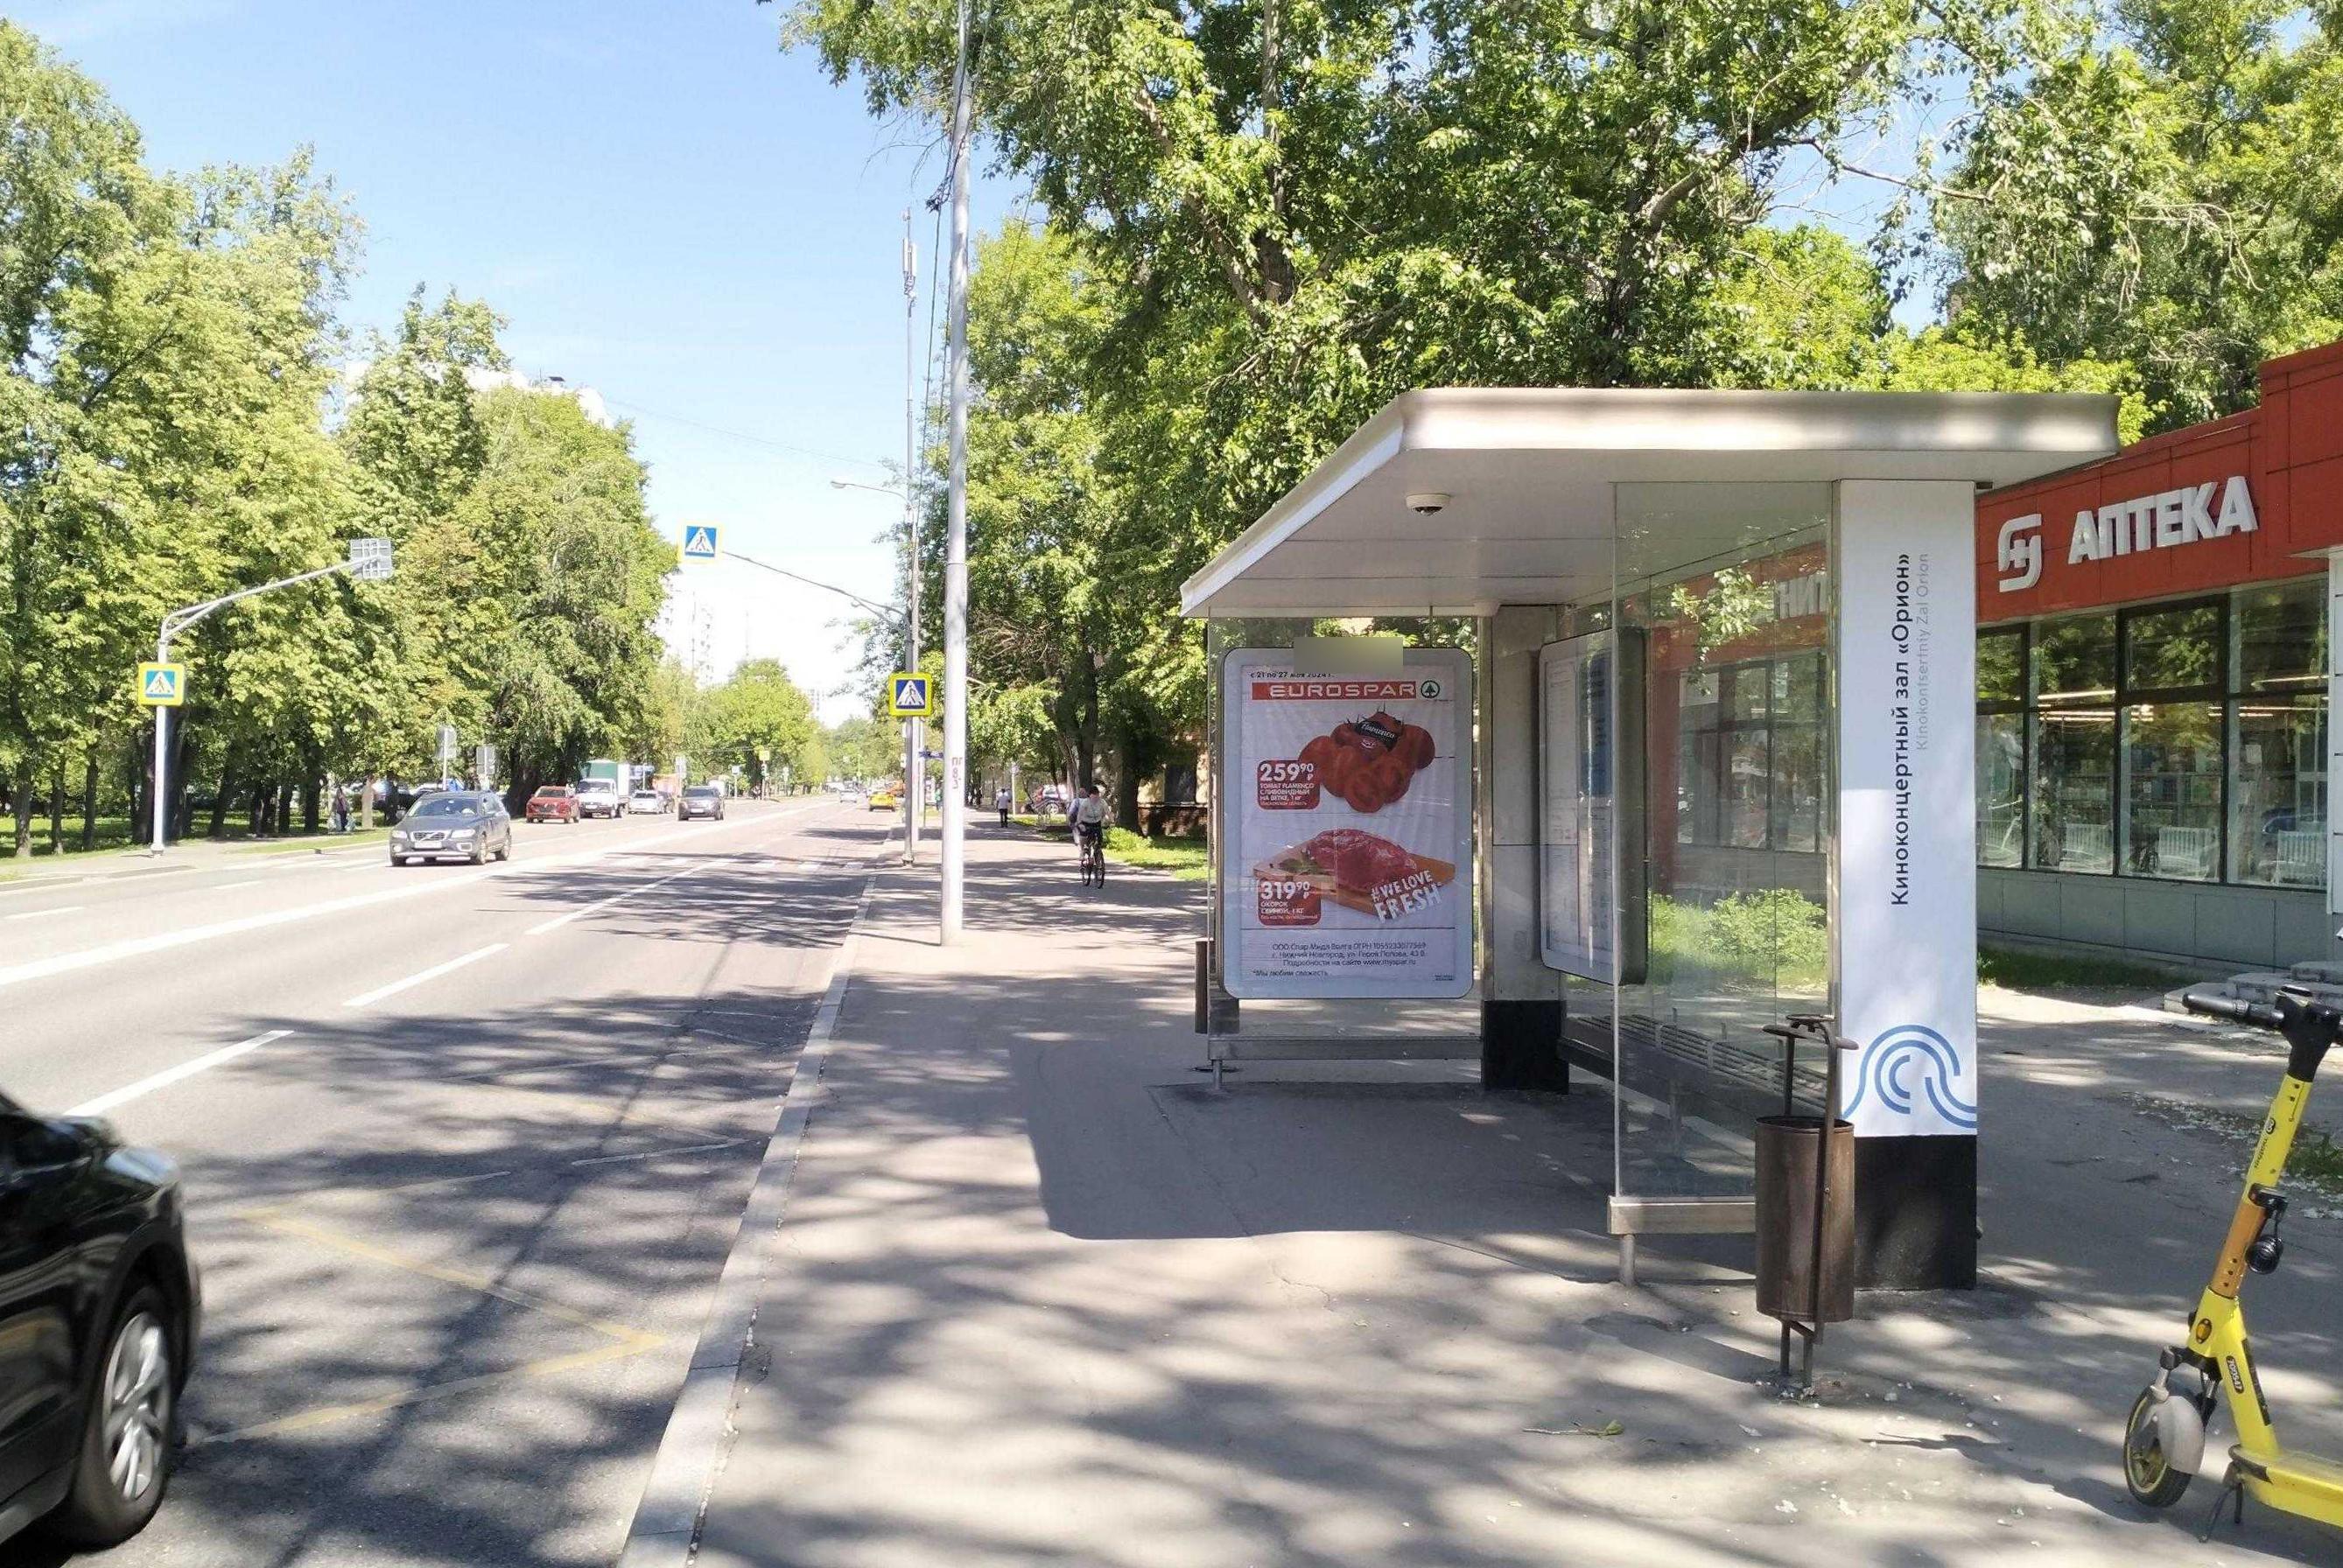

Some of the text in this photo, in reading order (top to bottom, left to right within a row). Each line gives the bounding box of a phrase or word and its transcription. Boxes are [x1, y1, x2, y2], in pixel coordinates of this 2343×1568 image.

[2068, 475, 2259, 564] АПТЕКА
[1916, 602, 1929, 625] Zal
[1269, 683, 1415, 698] EUROSPAR
[1891, 554, 1913, 906] Киноконцертный зал «Орион»
[1259, 763, 1301, 781] 259
[1300, 763, 1314, 773] 90
[1260, 881, 1296, 900] 319
[1296, 881, 1310, 891] 90
[1371, 870, 1433, 903] #WE LOVE
